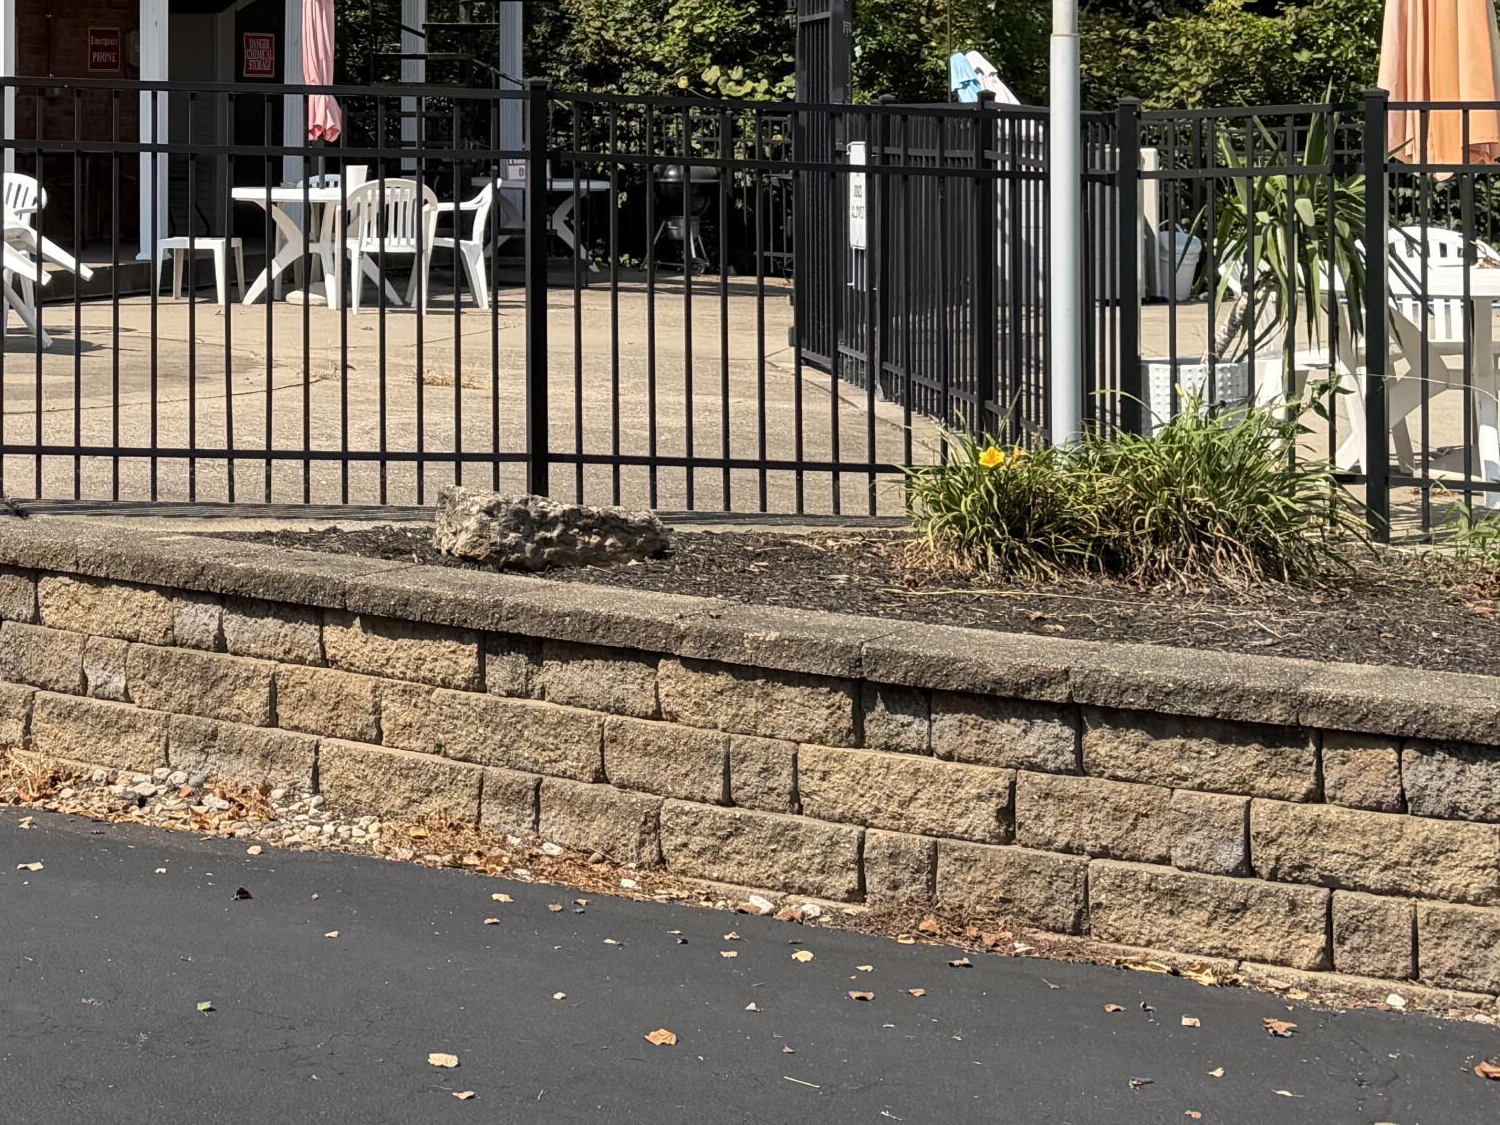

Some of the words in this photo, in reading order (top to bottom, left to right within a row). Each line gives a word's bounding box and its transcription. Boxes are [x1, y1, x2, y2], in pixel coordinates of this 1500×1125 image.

[91, 36, 118, 46] Emergency
[250, 38, 269, 49] DANGER
[92, 52, 117, 63] PHONE
[246, 49, 272, 59] CHEMICAL
[248, 60, 271, 70] STORAGE
